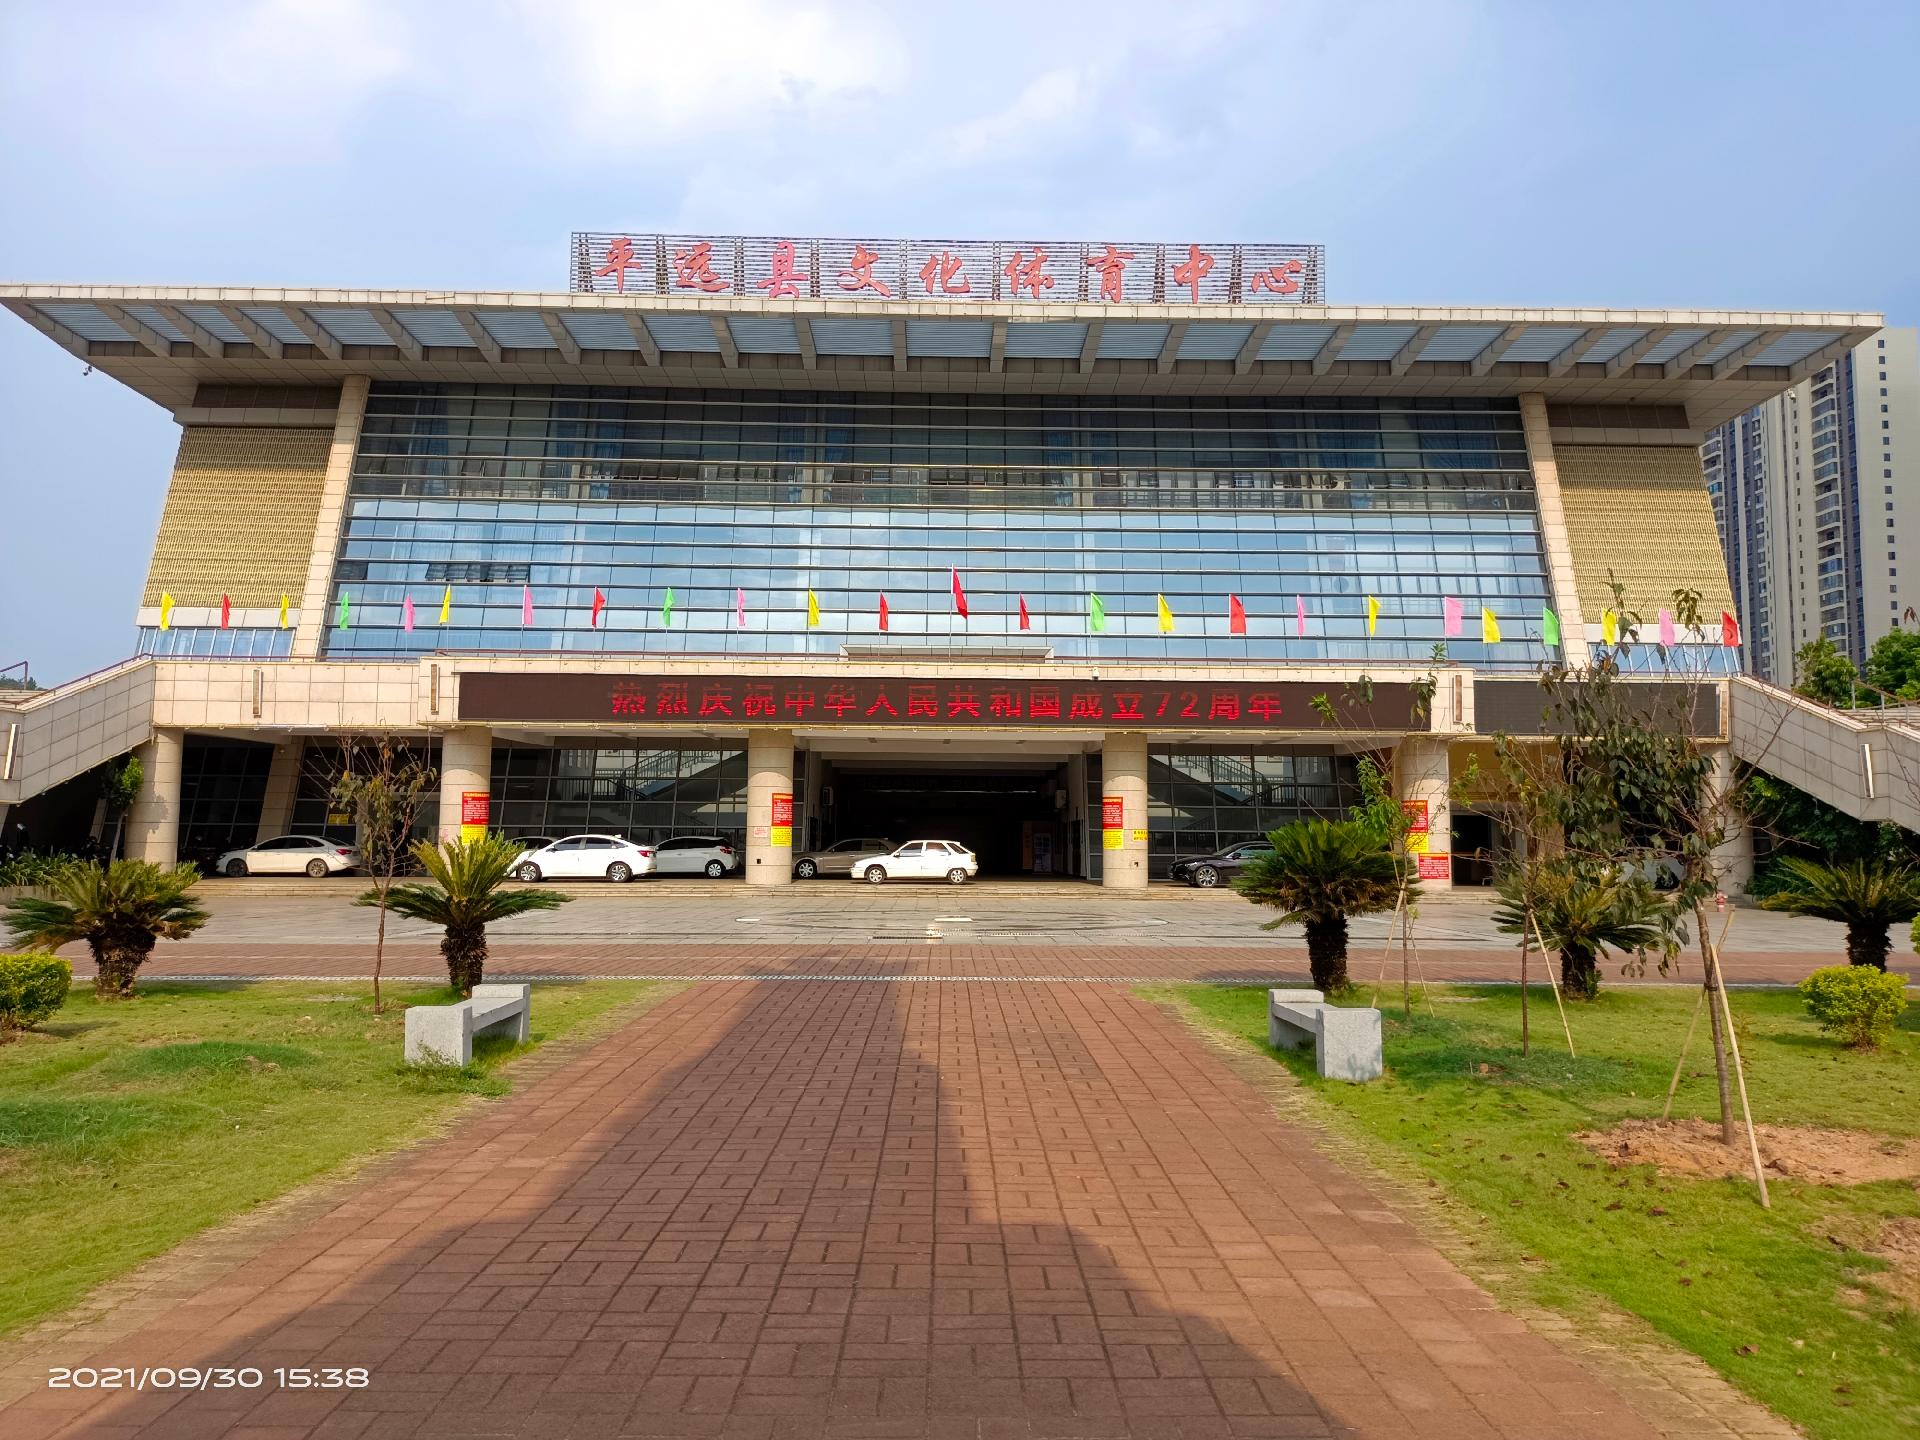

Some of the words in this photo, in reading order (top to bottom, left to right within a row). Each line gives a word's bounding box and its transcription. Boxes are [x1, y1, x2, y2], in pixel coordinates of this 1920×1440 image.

[595, 237, 1302, 304] 平远县文化体育中心
[611, 682, 1283, 721] 热烈庆祝中华人民共和国成立72周年
